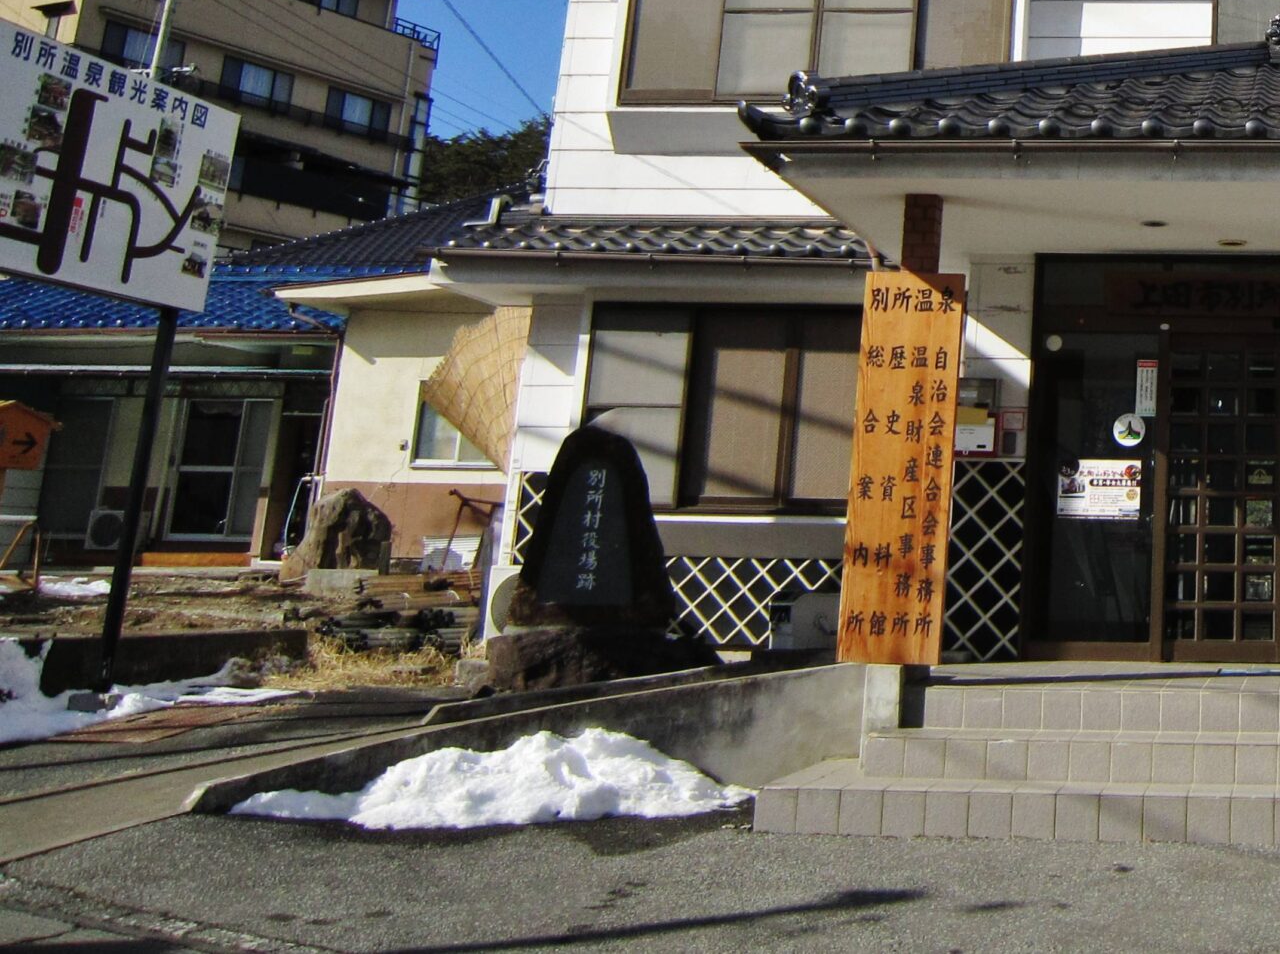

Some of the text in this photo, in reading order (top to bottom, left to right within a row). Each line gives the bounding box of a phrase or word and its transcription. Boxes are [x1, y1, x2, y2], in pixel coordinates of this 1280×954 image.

[11, 31, 209, 130] 別所温泉観光案内図
[869, 286, 956, 314] 別所温泉
[575, 468, 608, 592] 別所村役場跡
[846, 345, 886, 637] 総合案内所
[869, 345, 907, 637] 歴史資料館
[890, 345, 929, 638] 温泉財産区事務所
[914, 345, 949, 638] 自治会連合会事務所
